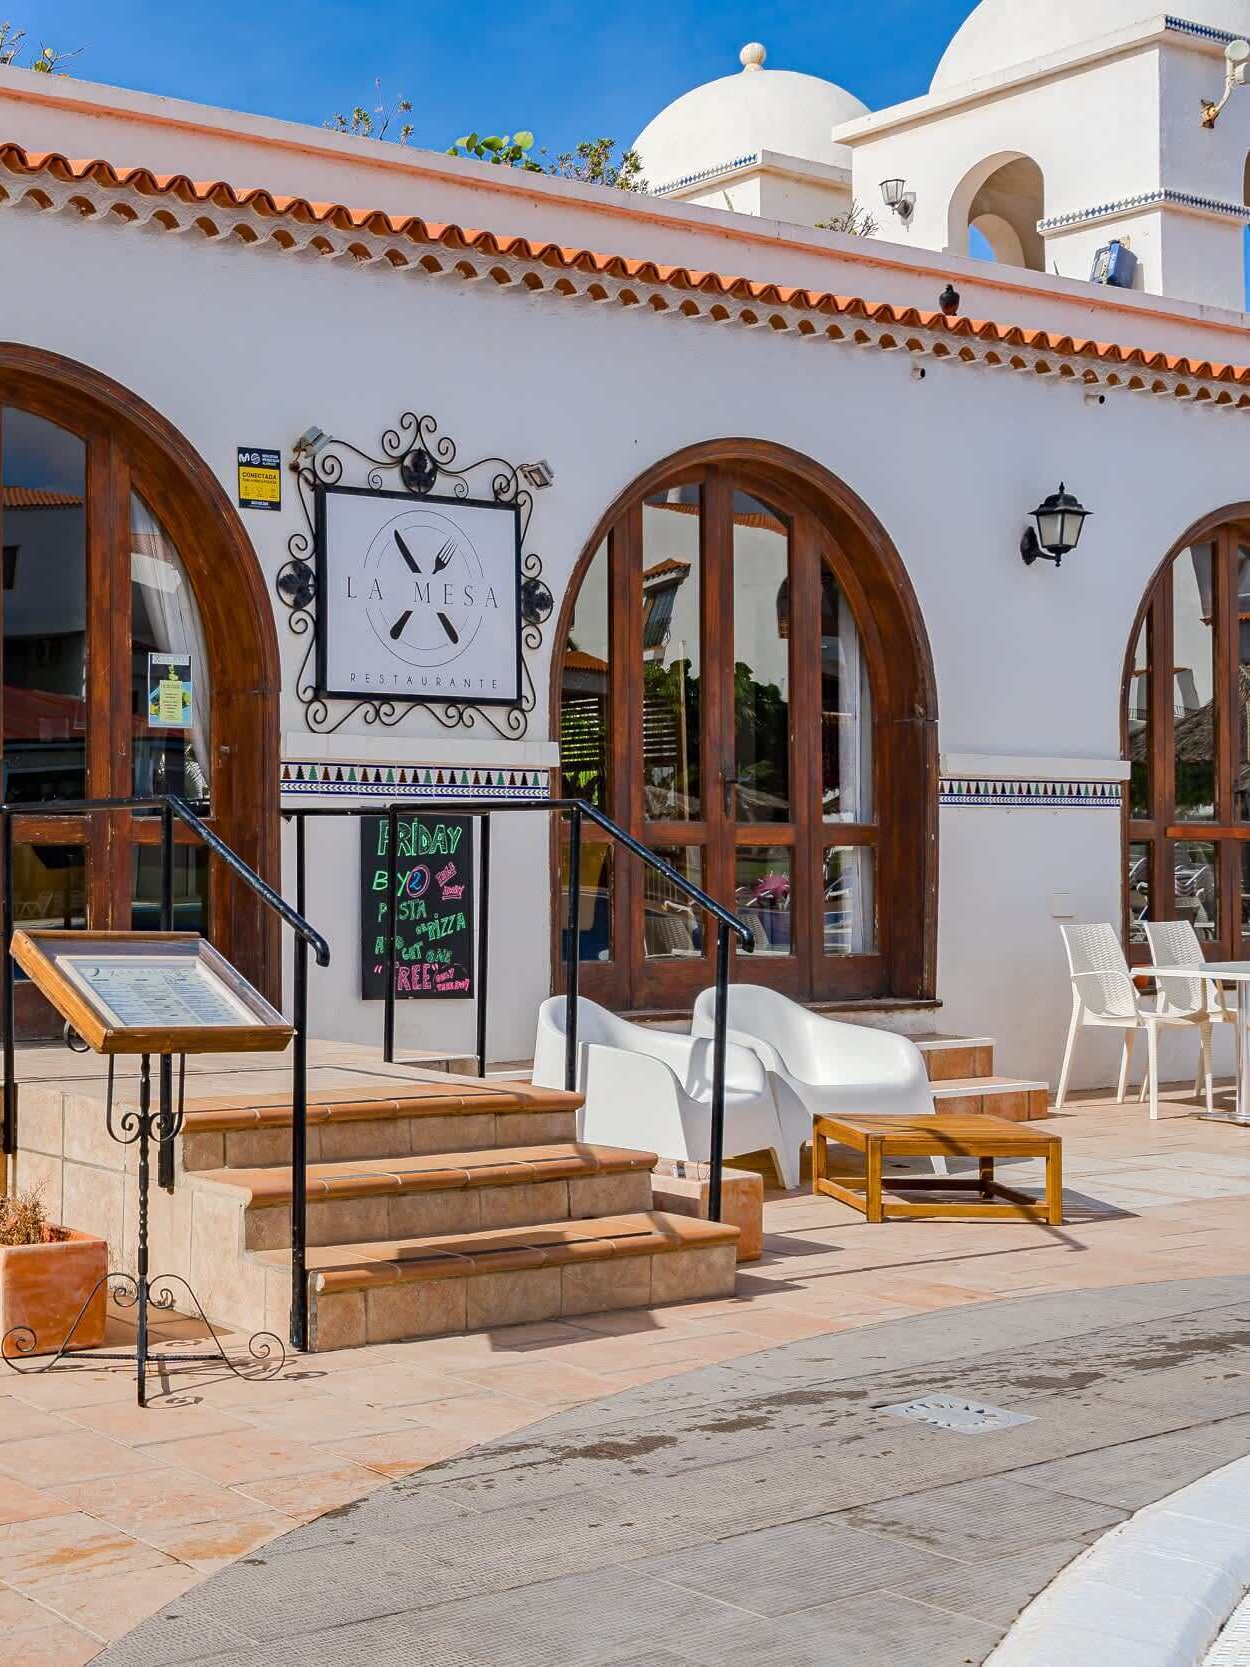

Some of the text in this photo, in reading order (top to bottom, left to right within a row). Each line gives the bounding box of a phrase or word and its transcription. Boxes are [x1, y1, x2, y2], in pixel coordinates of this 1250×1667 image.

[242, 471, 277, 480] CONECTADA
[347, 576, 498, 608] LA MESA
[350, 673, 498, 689] RESTAURANTE
[377, 818, 463, 857] FRIDAY
[372, 870, 411, 897] BY
[377, 898, 428, 923] PSTA
[428, 912, 467, 941] PIZZA
[375, 936, 405, 955] AD
[401, 941, 453, 963] GET ONE
